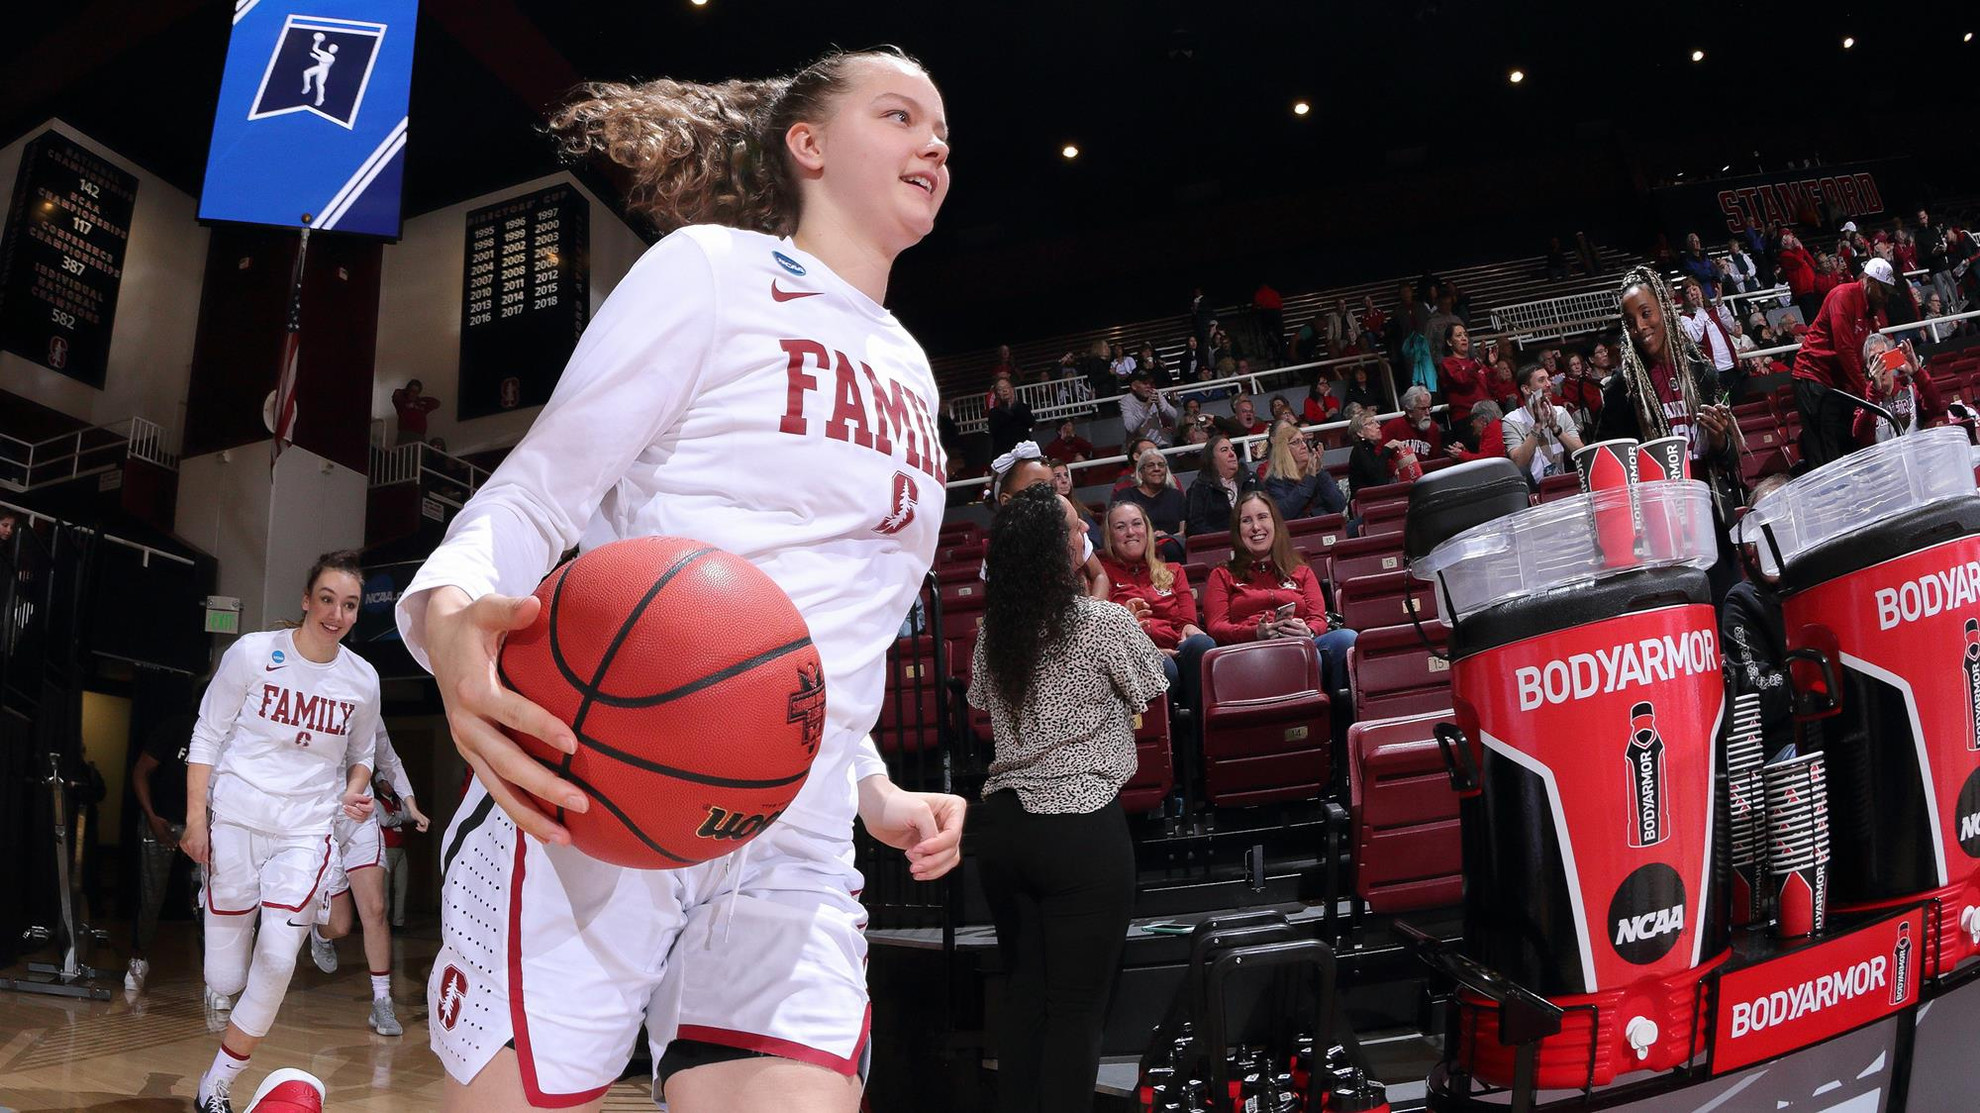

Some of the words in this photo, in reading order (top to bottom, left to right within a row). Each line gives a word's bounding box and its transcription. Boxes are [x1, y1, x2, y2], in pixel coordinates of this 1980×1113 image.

[79, 179, 100, 199] 142
[1718, 172, 1884, 233] STANFORD
[73, 216, 92, 235] 117
[473, 238, 494, 250] 1998
[504, 229, 526, 242] 1999
[535, 220, 559, 233] 2000
[474, 226, 495, 239] 1995
[505, 217, 526, 230] 1996
[537, 208, 559, 221] 1997
[471, 262, 494, 276] 2004
[502, 253, 526, 267] 2005
[534, 244, 559, 258] 2006
[472, 250, 494, 263] 2001
[502, 241, 526, 254] 2002
[534, 232, 559, 246] 2003
[61, 255, 86, 276] 387
[471, 274, 493, 288] 2007
[501, 266, 526, 280] 2008
[534, 257, 559, 271] 2009
[470, 287, 492, 300] 2010
[503, 279, 524, 292] 2011
[535, 270, 558, 283] 2012
[470, 300, 492, 313] 2013
[501, 291, 524, 305] 2014
[535, 283, 558, 296] 2015
[51, 308, 76, 329] 582
[469, 313, 491, 326] 2016
[501, 304, 524, 318] 2017
[534, 296, 558, 310] 2018
[1515, 629, 1718, 712] BODYARMOR
[259, 684, 355, 736] FAMILY
[1640, 750, 1656, 842] BODYARMOR
[1615, 904, 1684, 946] NCAA
[1896, 949, 1906, 1002] BODYARMOR
[1731, 955, 1887, 1039] BODYARMOR
